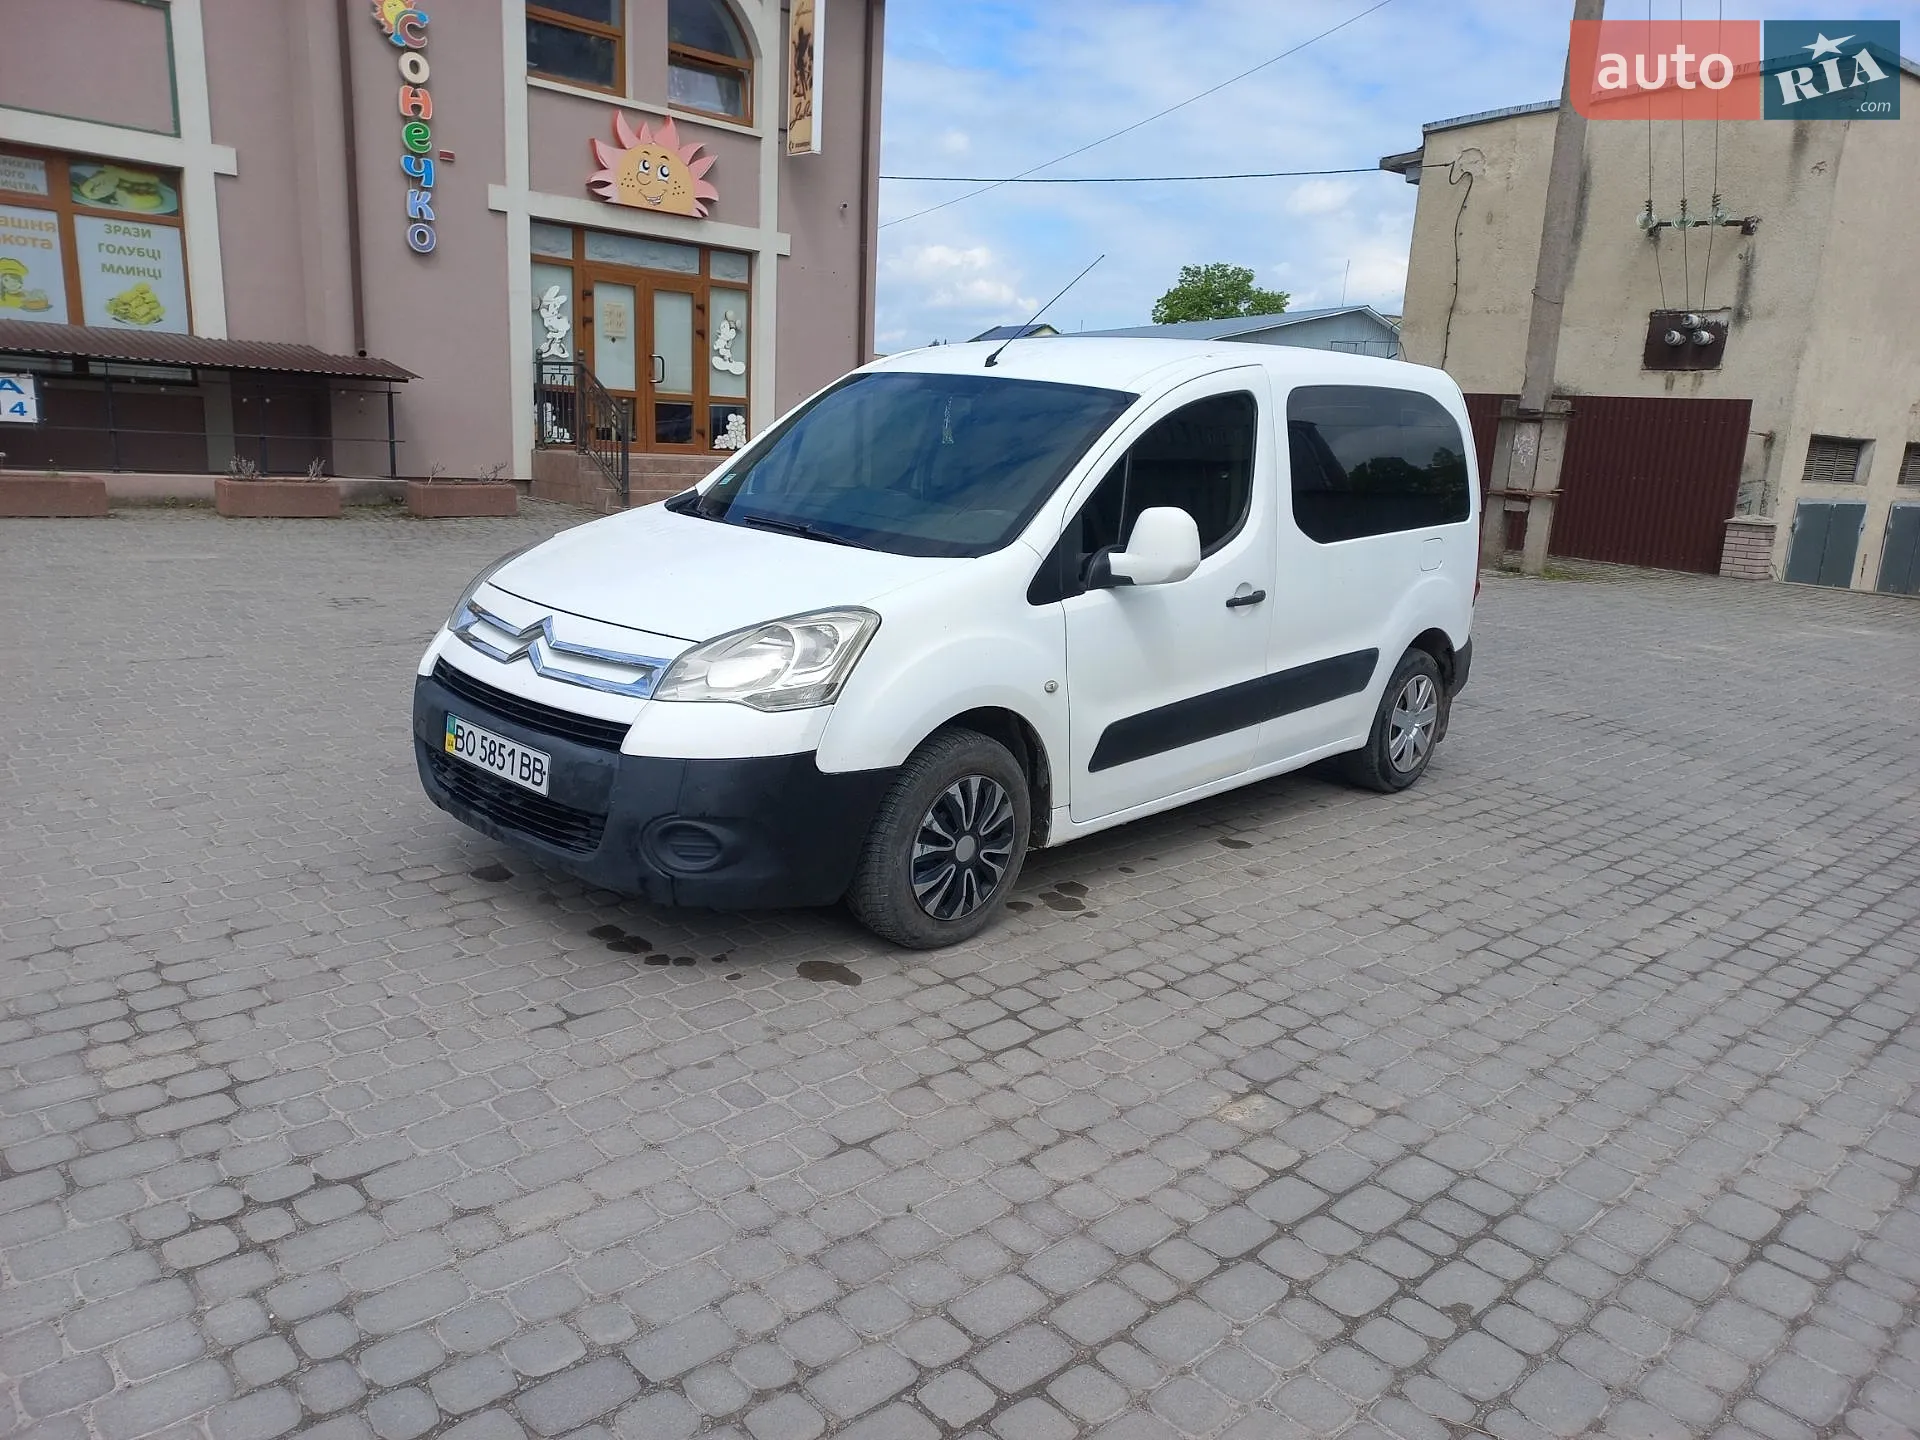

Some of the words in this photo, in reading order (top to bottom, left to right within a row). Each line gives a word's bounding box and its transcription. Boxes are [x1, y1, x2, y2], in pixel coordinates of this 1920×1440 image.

[397, 9, 436, 253] Сонечко
[104, 223, 152, 239] ЗРАЗИ
[0, 233, 53, 250] кота
[97, 242, 161, 261] ГОЛУБЦІ
[101, 263, 162, 280] МЛИНЦІ
[454, 724, 476, 757] BO
[479, 735, 516, 776] 5851
[519, 751, 545, 787] BB
